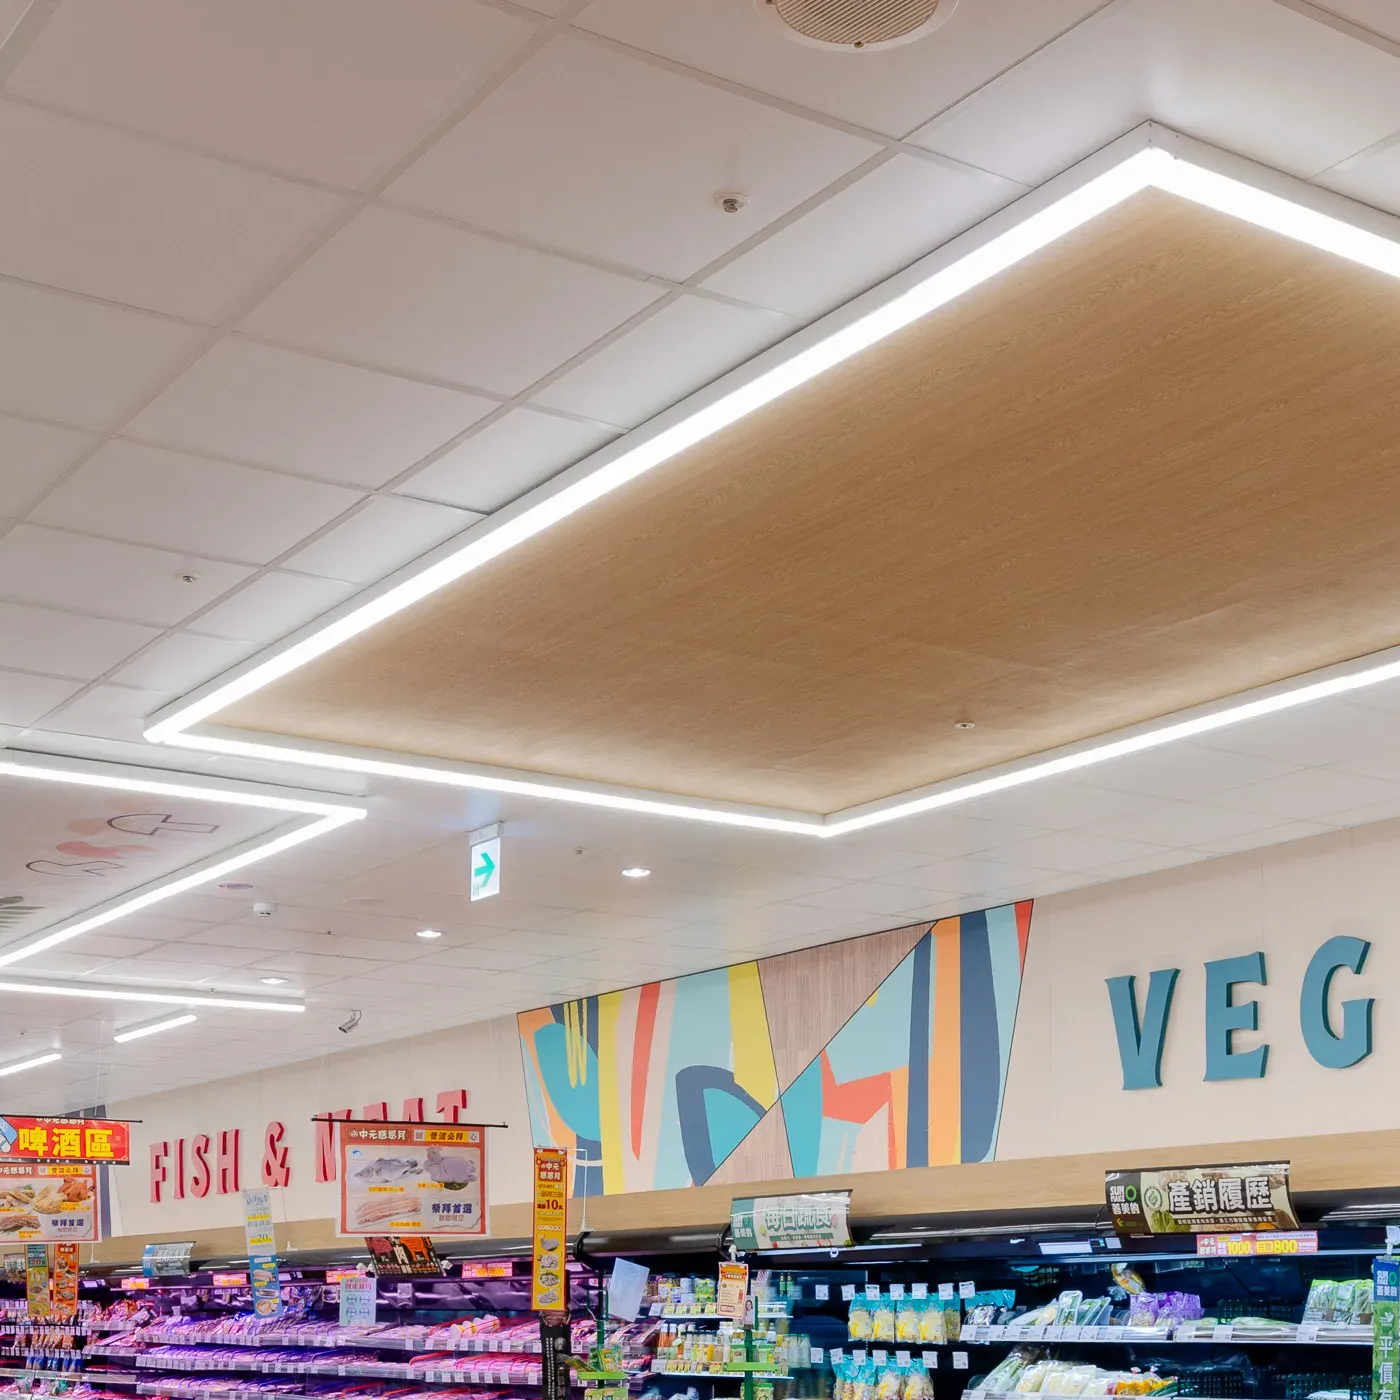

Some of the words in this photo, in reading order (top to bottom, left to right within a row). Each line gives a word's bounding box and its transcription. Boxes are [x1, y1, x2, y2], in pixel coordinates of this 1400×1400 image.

[18, 1126, 114, 1158] 啤酒區
[150, 1128, 240, 1203] FISH
[261, 1121, 291, 1187] &
[1112, 1202, 1140, 1215] 善美的
[1168, 1175, 1274, 1213] 產銷履歷
